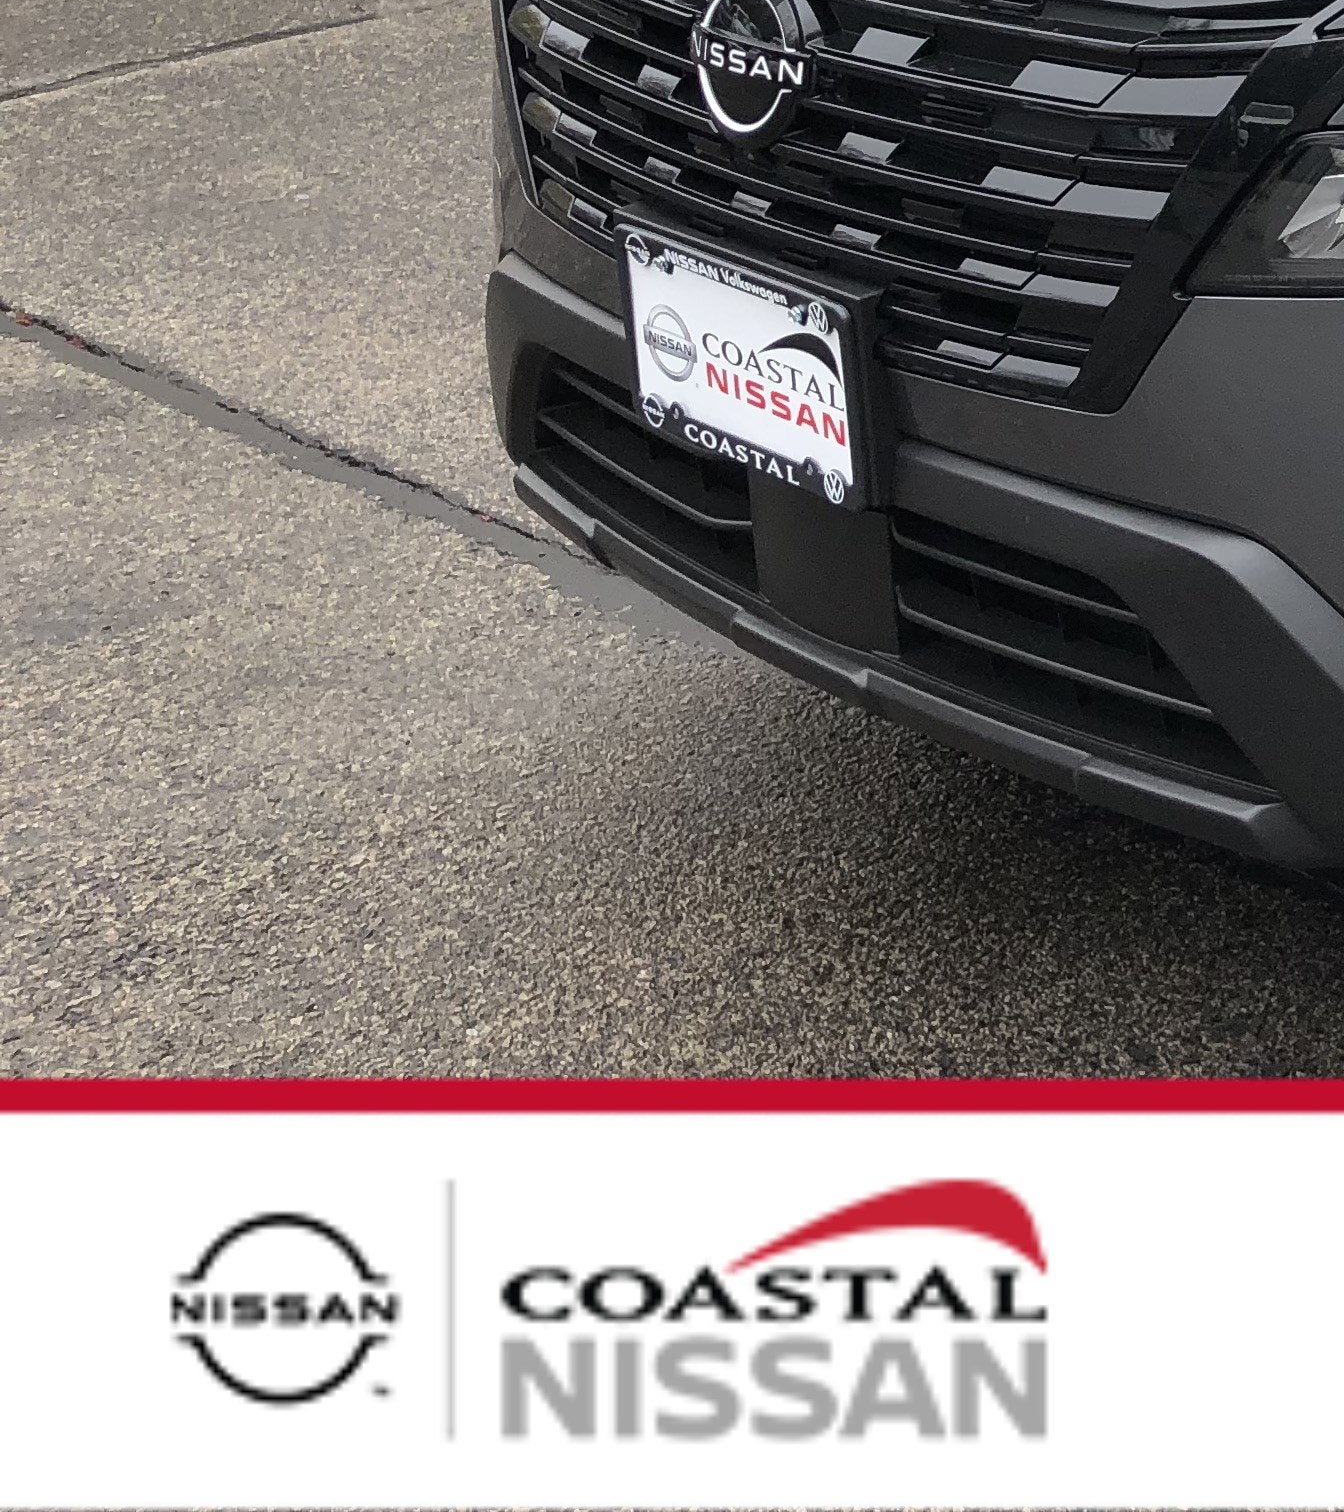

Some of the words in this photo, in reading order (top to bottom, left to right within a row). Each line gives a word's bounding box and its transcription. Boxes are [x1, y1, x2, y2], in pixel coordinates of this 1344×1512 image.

[663, 248, 719, 282] NISSAN
[720, 267, 788, 306] Volkswagen
[650, 331, 692, 357] NISSAN
[702, 332, 845, 412] COASTAL
[706, 361, 846, 447] NISSAN
[684, 423, 800, 486] COASTAL
